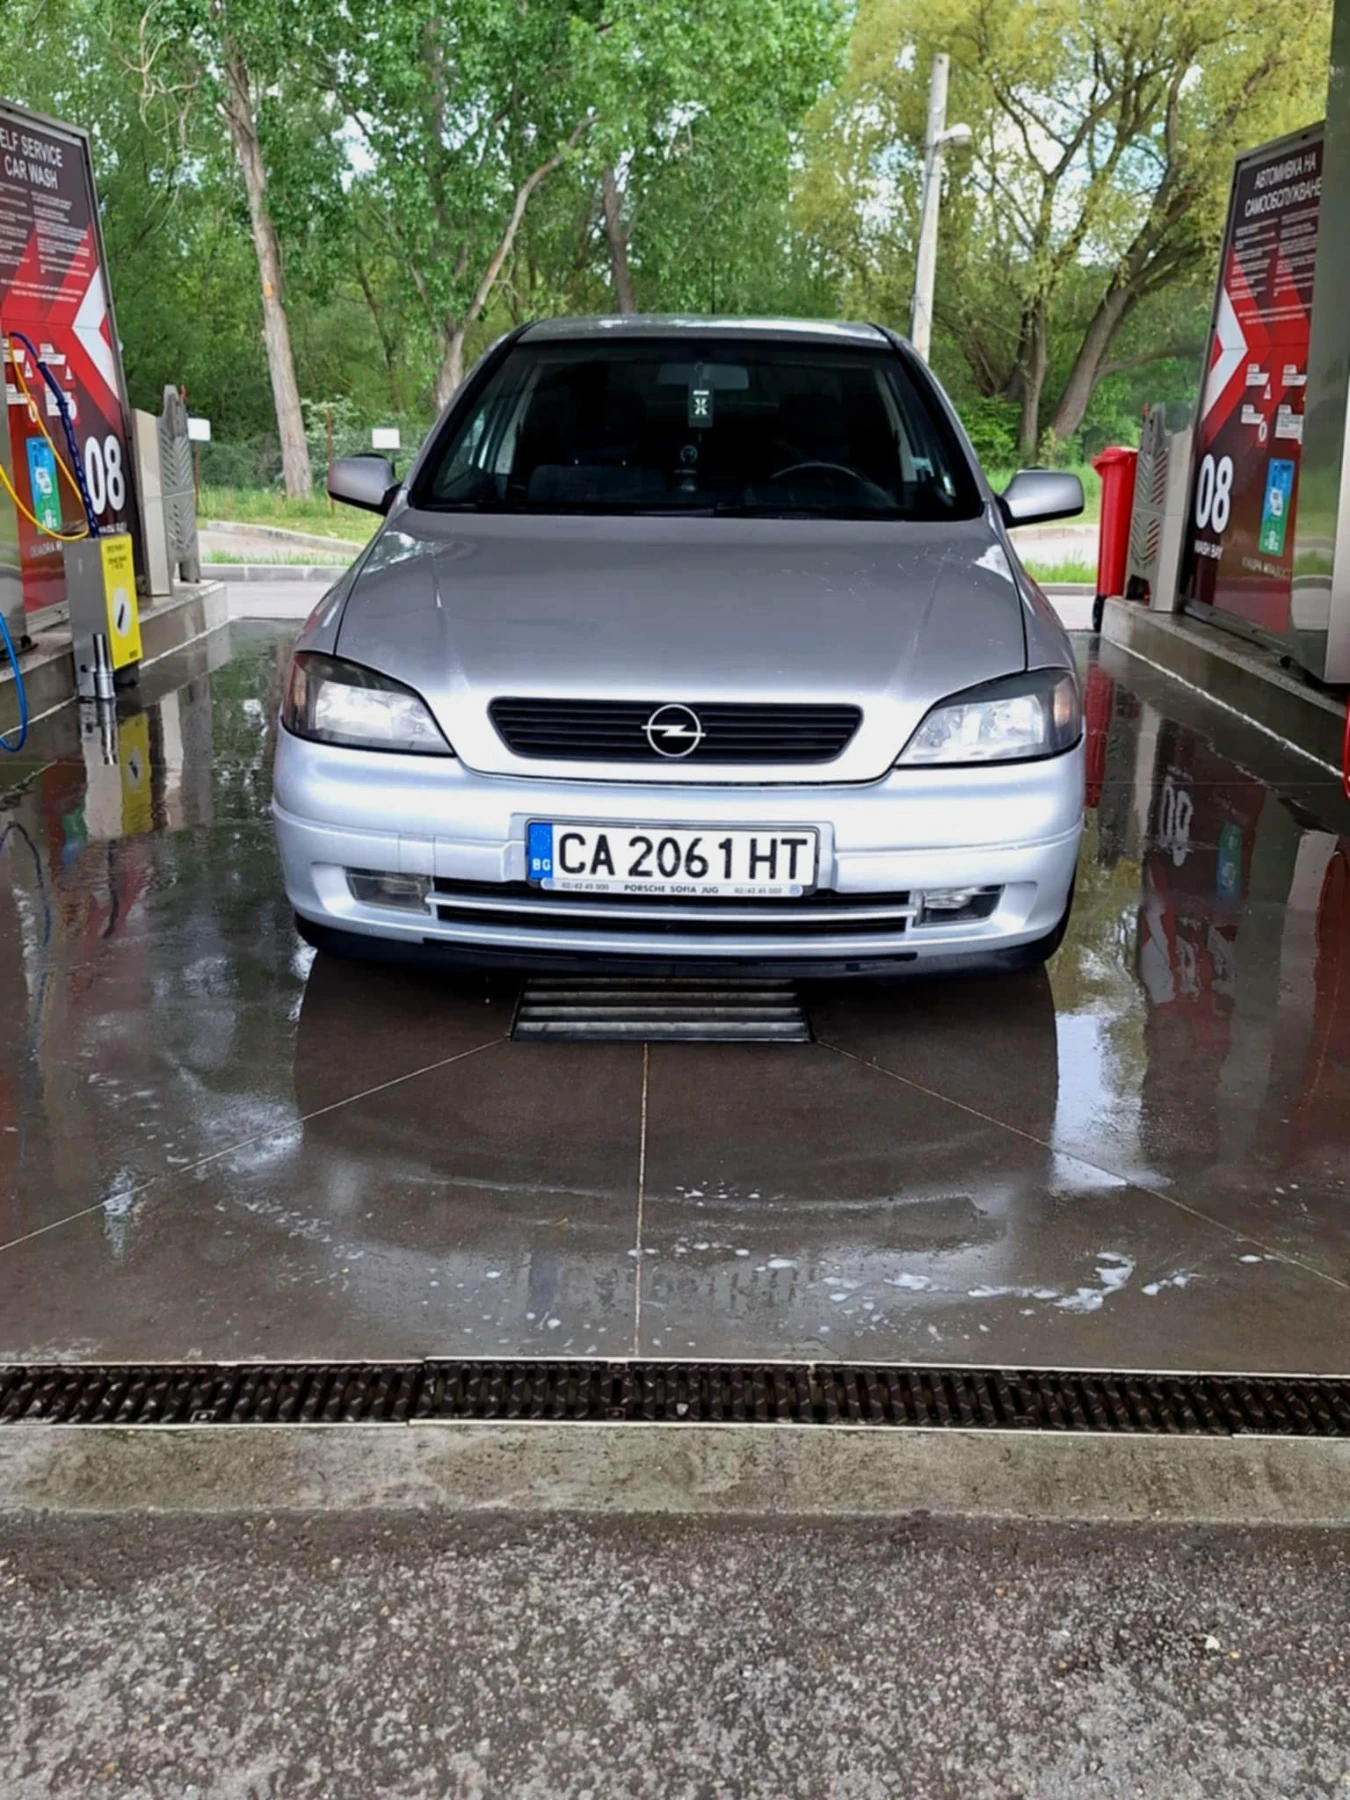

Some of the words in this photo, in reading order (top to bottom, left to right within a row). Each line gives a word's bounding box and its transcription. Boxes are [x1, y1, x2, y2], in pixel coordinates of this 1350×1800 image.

[0, 127, 18, 151] ELF
[21, 135, 63, 168] SERVICE
[4, 155, 28, 181] CAR
[28, 162, 58, 190] WASH
[84, 435, 126, 515] 08
[1196, 453, 1234, 533] 08
[532, 858, 551, 871] BG
[559, 832, 615, 876] CA
[628, 836, 732, 879] 2061
[750, 838, 808, 880] HT
[624, 884, 665, 893] PORSCHE
[670, 885, 697, 894] SOFIA
[702, 886, 719, 894] JUG
